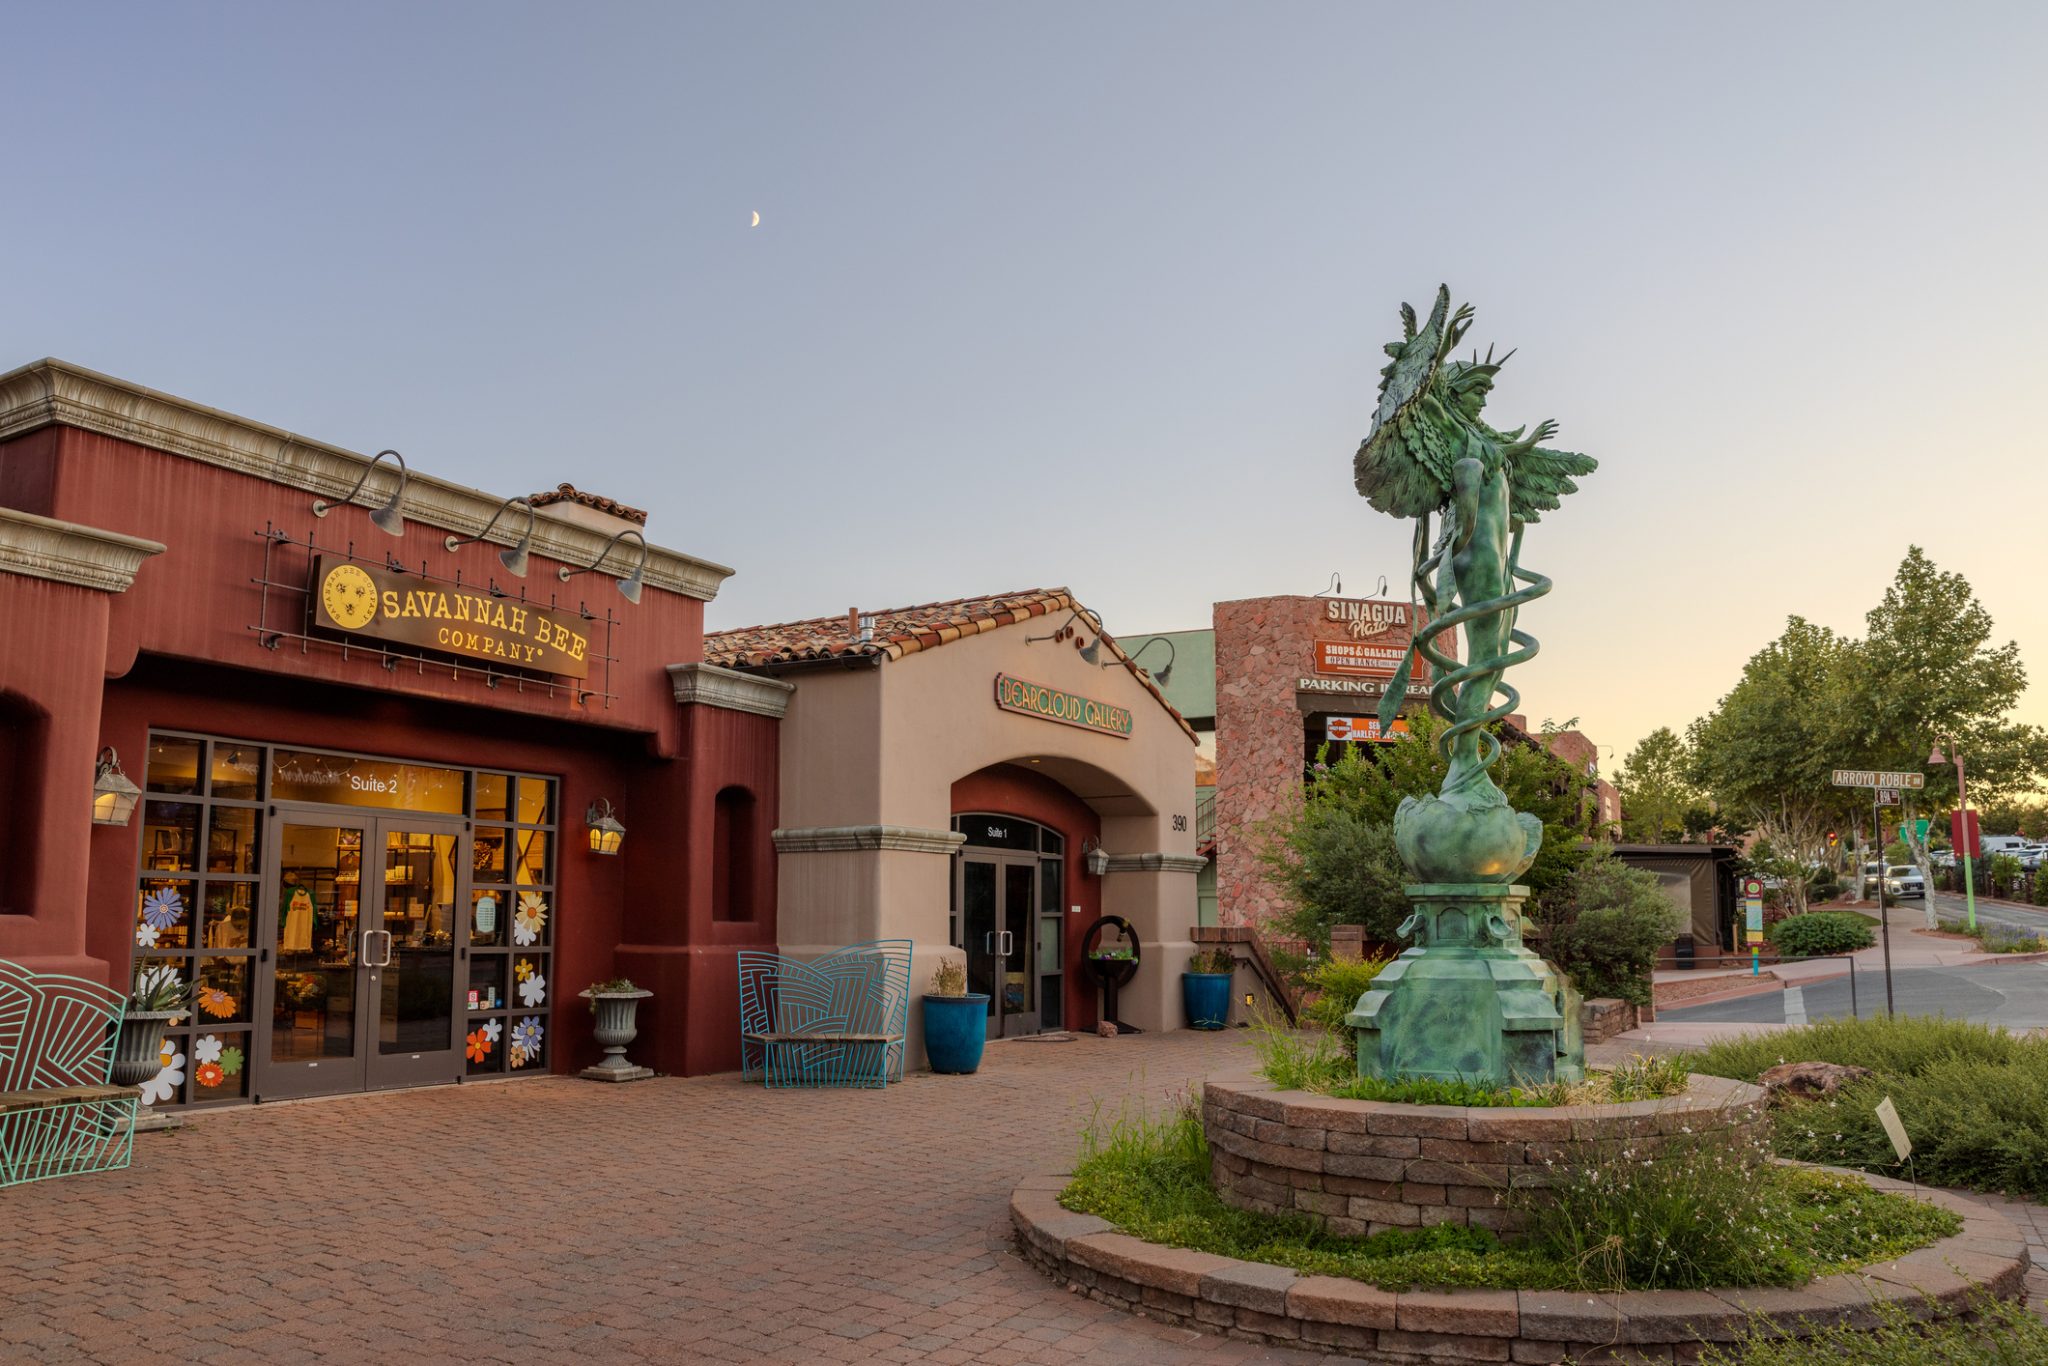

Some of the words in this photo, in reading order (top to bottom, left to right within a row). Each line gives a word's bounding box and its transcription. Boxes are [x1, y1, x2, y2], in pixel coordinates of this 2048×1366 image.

[1328, 600, 1407, 624] SINAGUA
[382, 590, 528, 635] SAVANNAH
[534, 616, 588, 661] BEE
[1348, 619, 1388, 639] Plaza
[438, 627, 536, 663] COMPANY
[1325, 644, 1356, 656] SHOPS
[1355, 646, 1363, 657] &
[1364, 647, 1408, 660] GALLERIE
[1300, 678, 1375, 693] PARKING
[1004, 679, 1081, 721] BEARCLOUD
[1085, 701, 1129, 731] GALLERY
[351, 775, 385, 792] Suite
[389, 780, 397, 793] 2
[1836, 772, 1875, 785] ARROYO
[1880, 773, 1911, 787] ROBLE
[988, 826, 1002, 838] Suite
[1173, 814, 1187, 832] 390
